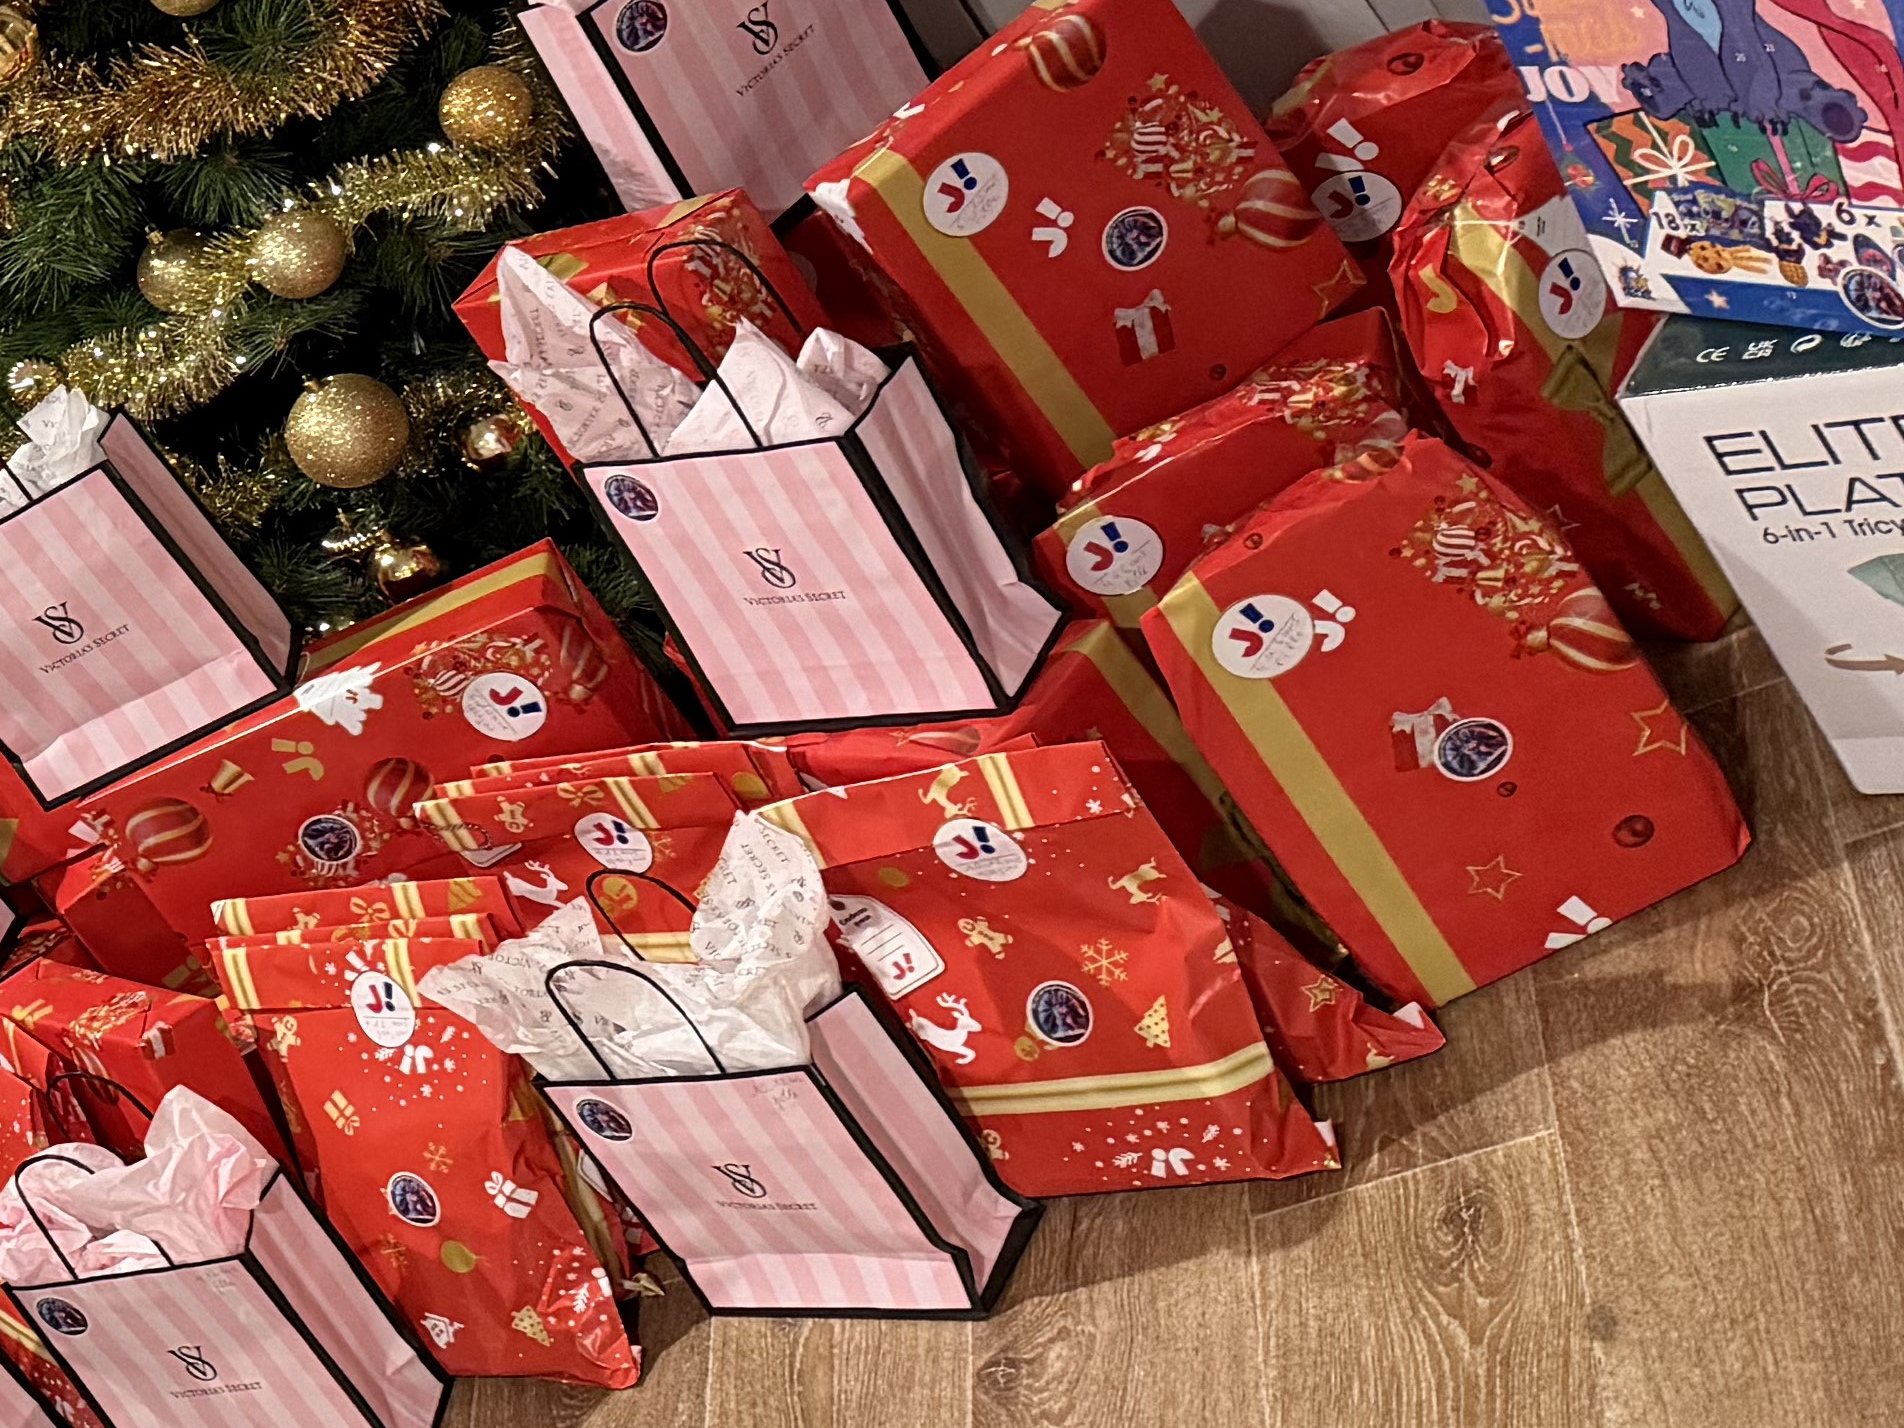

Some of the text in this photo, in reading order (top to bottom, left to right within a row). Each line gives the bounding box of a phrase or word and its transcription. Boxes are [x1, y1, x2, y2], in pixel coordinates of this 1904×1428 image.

[1518, 64, 1623, 104] JOY
[1650, 210, 1681, 232] 18
[1835, 202, 1857, 226] 6
[1763, 521, 1838, 545] 6-in-1
[91, 623, 130, 649] SECRET
